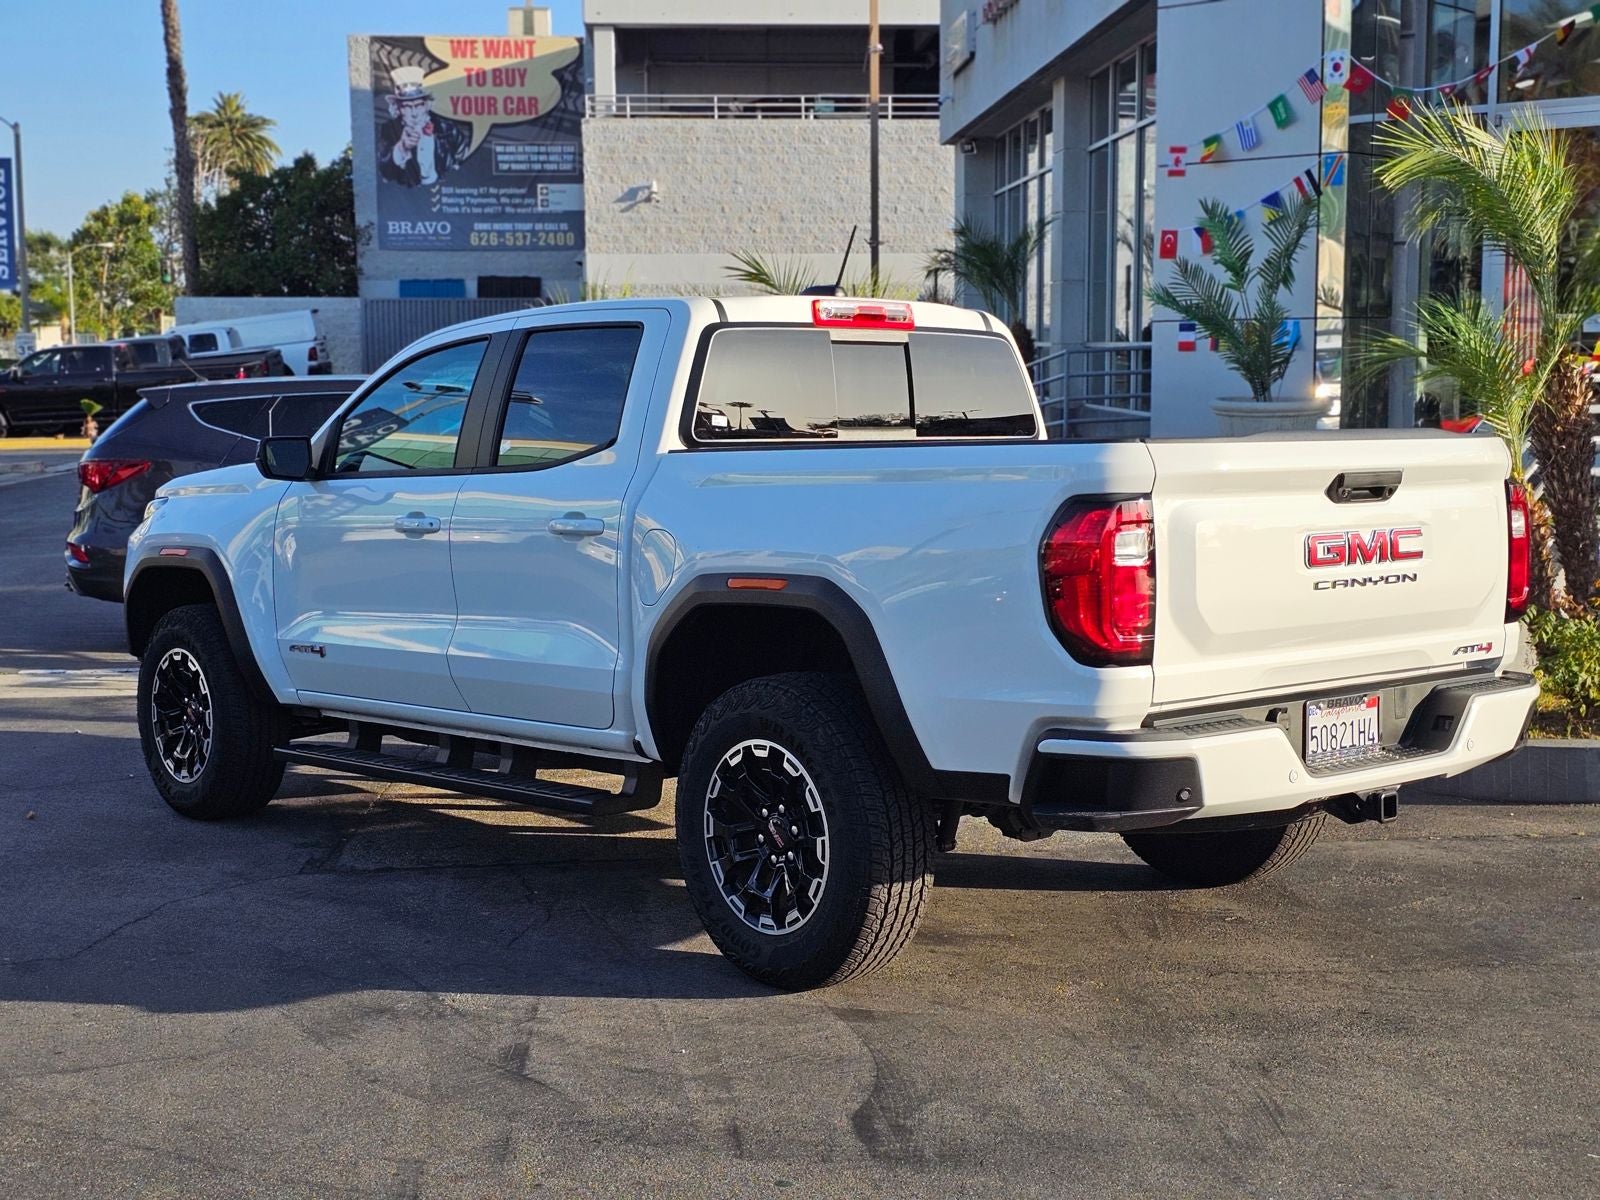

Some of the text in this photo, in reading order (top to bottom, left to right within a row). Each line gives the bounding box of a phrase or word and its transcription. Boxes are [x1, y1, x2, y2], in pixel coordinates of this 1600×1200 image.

[449, 38, 536, 60] WE WANT
[464, 66, 527, 88] TO BUY
[449, 95, 539, 117] YOUR CAR
[387, 221, 452, 235] BRAVO
[470, 231, 575, 246] 626-537-2400
[1304, 527, 1424, 570] GMC
[1313, 573, 1418, 591] CANYON
[289, 644, 327, 658] AT4
[1452, 642, 1493, 655] AT4
[1327, 695, 1363, 709] BRAVO
[1310, 717, 1376, 755] 50821H4
